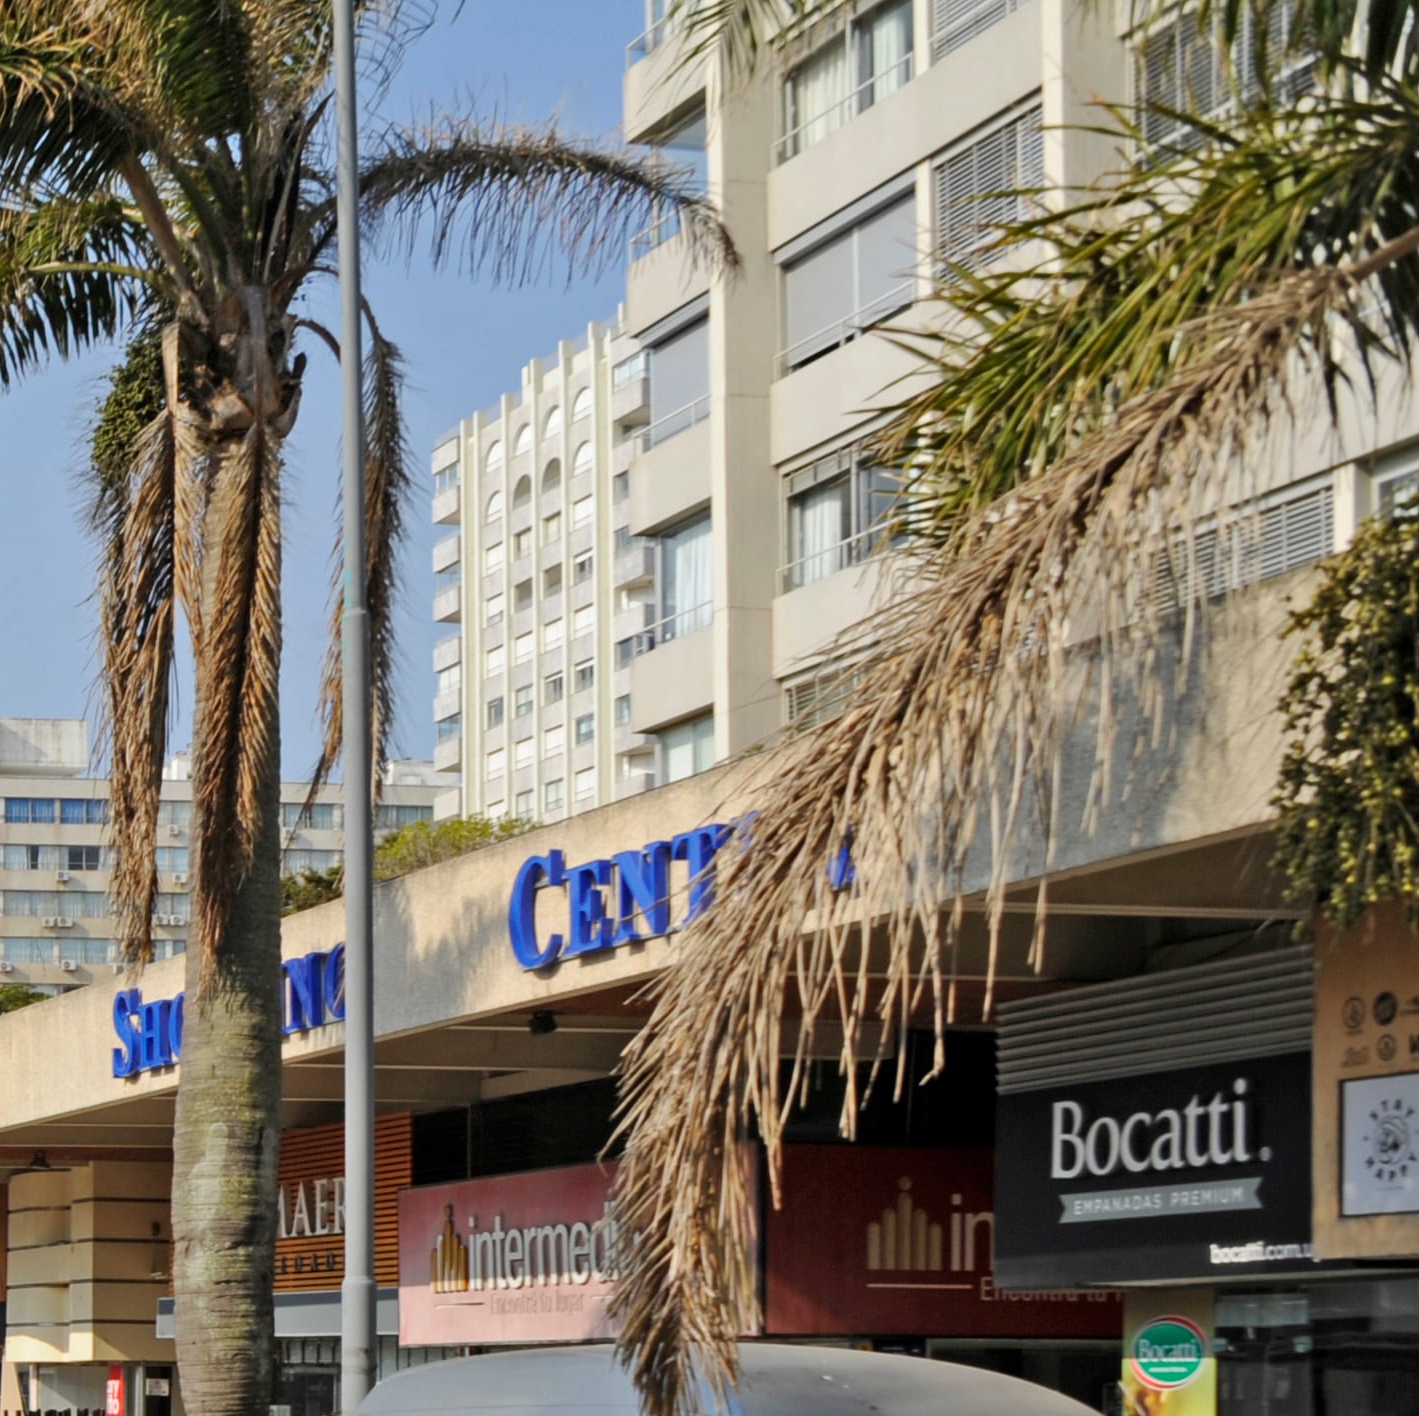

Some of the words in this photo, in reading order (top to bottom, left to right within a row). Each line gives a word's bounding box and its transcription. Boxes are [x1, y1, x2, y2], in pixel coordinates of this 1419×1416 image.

[1074, 1193, 1162, 1216] EMPANADAS
[1170, 1186, 1244, 1207] PREMIUM
[1138, 1339, 1198, 1362] Bocatti
